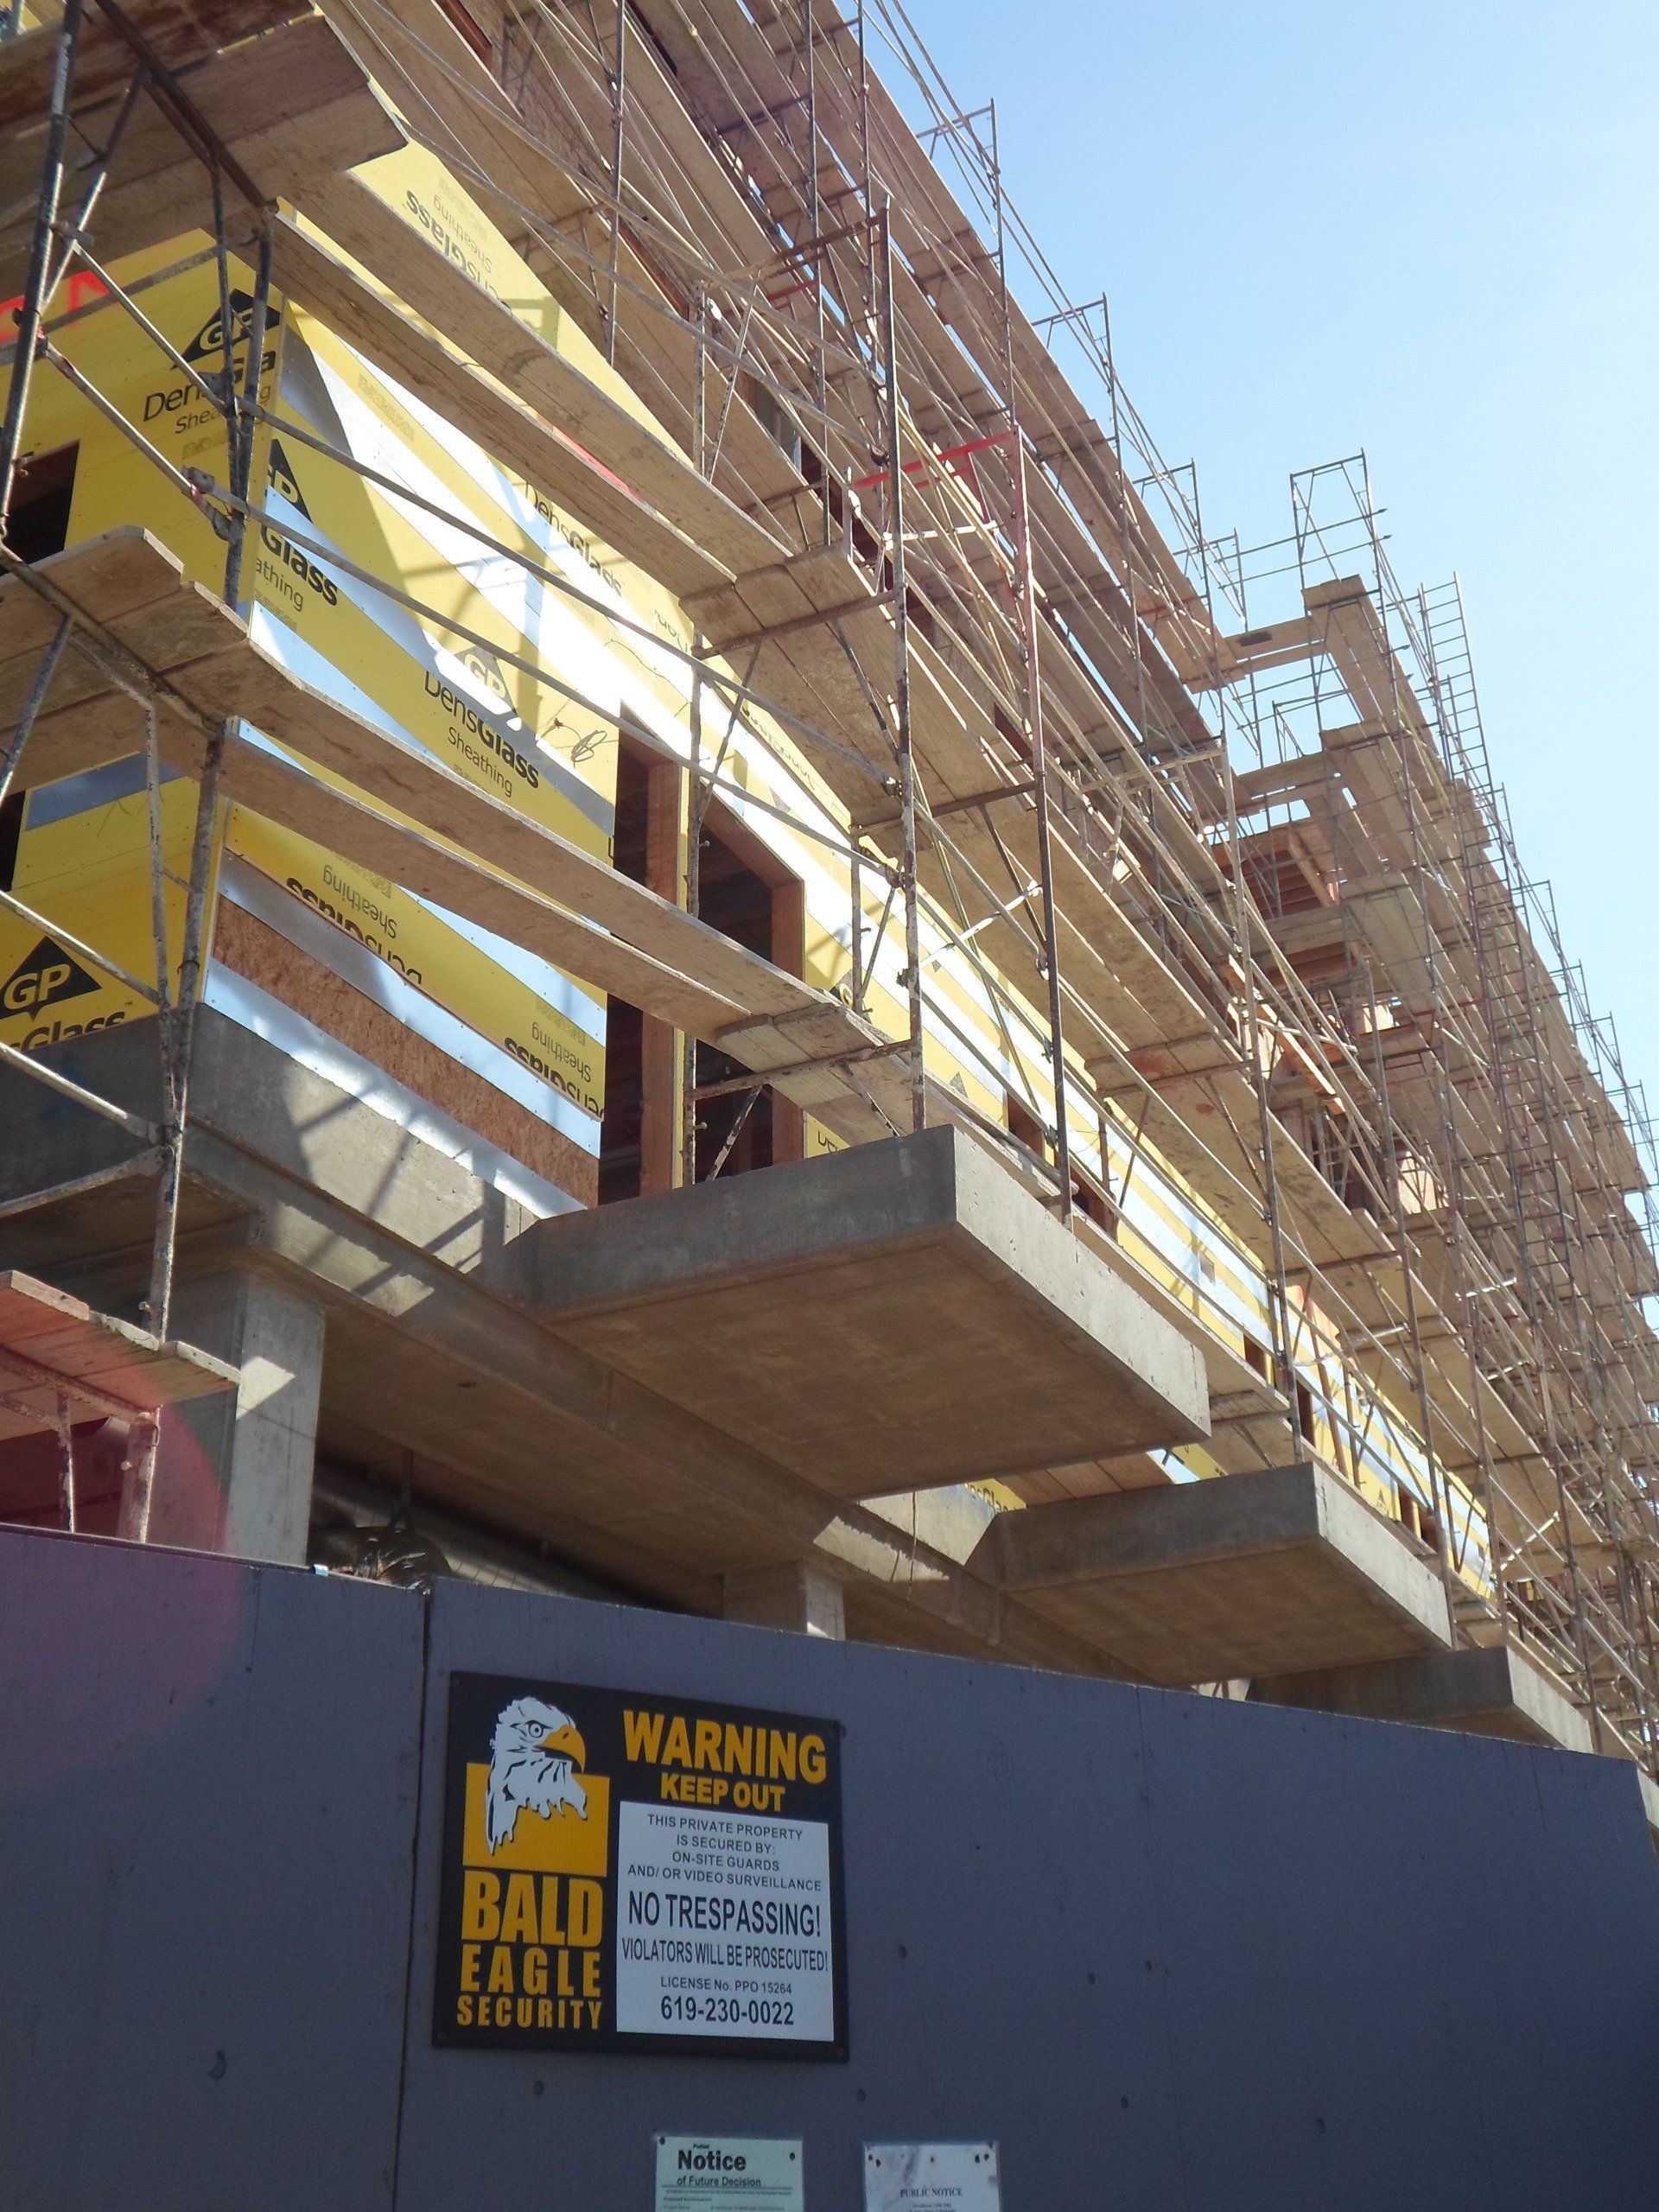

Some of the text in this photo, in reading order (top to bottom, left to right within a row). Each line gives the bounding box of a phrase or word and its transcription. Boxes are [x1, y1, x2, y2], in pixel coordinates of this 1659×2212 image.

[433, 194, 493, 274] Sheathing
[424, 671, 539, 789] DensGlass
[447, 726, 513, 798] Sheathing
[322, 864, 397, 939] Sheathing
[3, 963, 71, 1010] GP
[531, 1021, 592, 1084] Sheathing
[623, 1710, 827, 1784] WARNING
[660, 1772, 785, 1812] KEEP OUT
[647, 1814, 804, 1840] THIS PRIVATE PROPERTY
[676, 1834, 776, 1855] IS SECURED BY:
[627, 1864, 822, 1891] AND/ OR VIDEO SURVEILLANCE
[671, 1852, 779, 1872] ON-SITE GUARDS
[461, 1870, 604, 1948] BALD
[628, 1891, 822, 1938] NO TRESPASSING!
[460, 1943, 601, 1999] EAGLE
[621, 1937, 829, 1972] VIOLATORS WILL BE PROSECUTED!
[660, 1975, 792, 1994] LICENSE No. PPO 15264
[456, 1994, 602, 2030] SECURITY
[660, 1995, 794, 2025] 619-230-0022
[677, 2149, 747, 2171] Notice
[677, 2176, 762, 2188] of Future Decision
[899, 2187, 963, 2198] PUBLIC NOTICE
